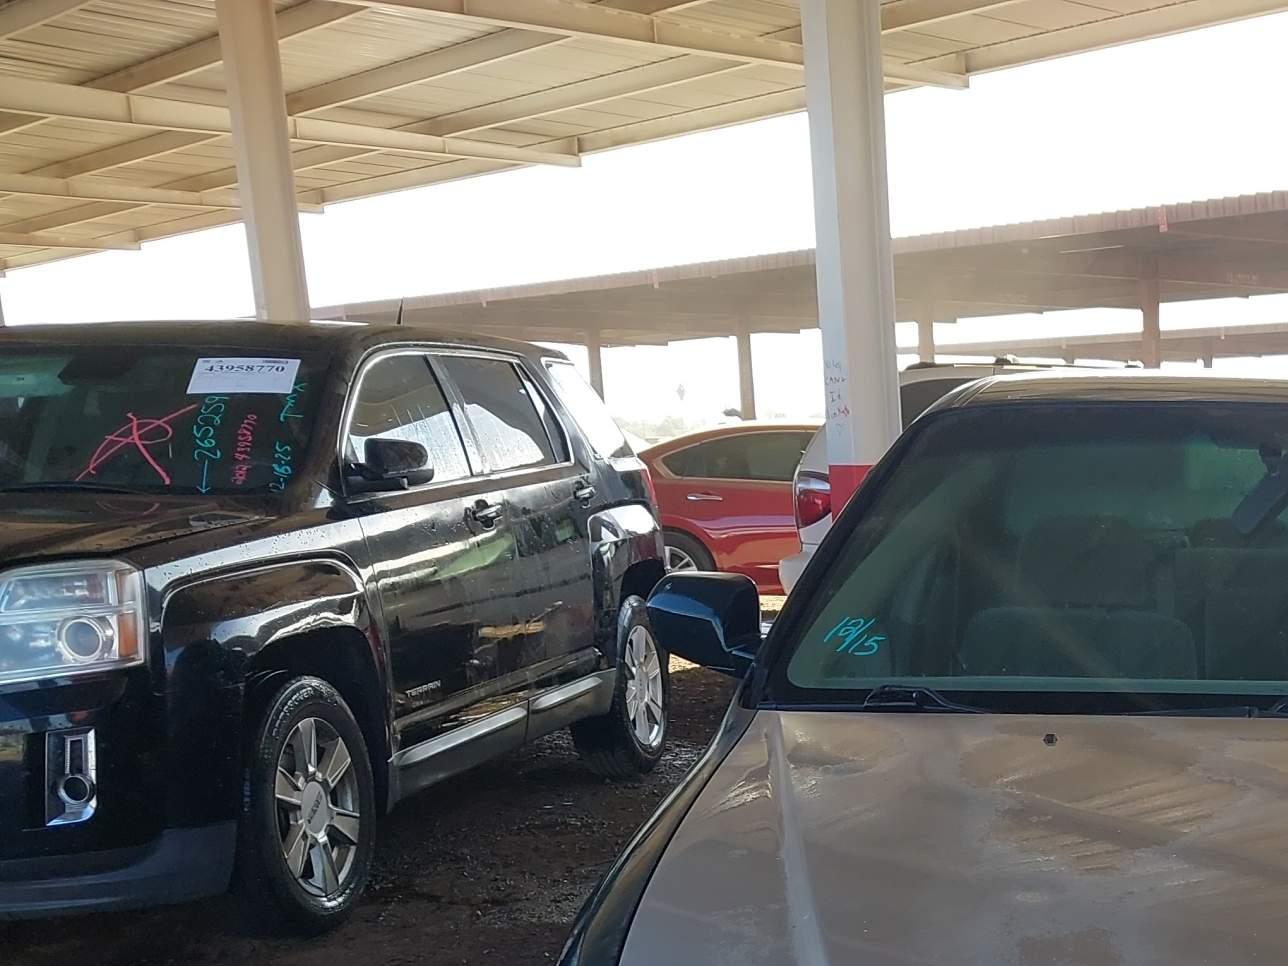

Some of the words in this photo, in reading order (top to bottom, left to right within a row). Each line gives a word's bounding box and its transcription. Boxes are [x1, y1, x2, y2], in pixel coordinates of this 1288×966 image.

[204, 364, 286, 373] 43958770
[193, 395, 231, 462] 265259
[823, 616, 887, 657] 12/15
